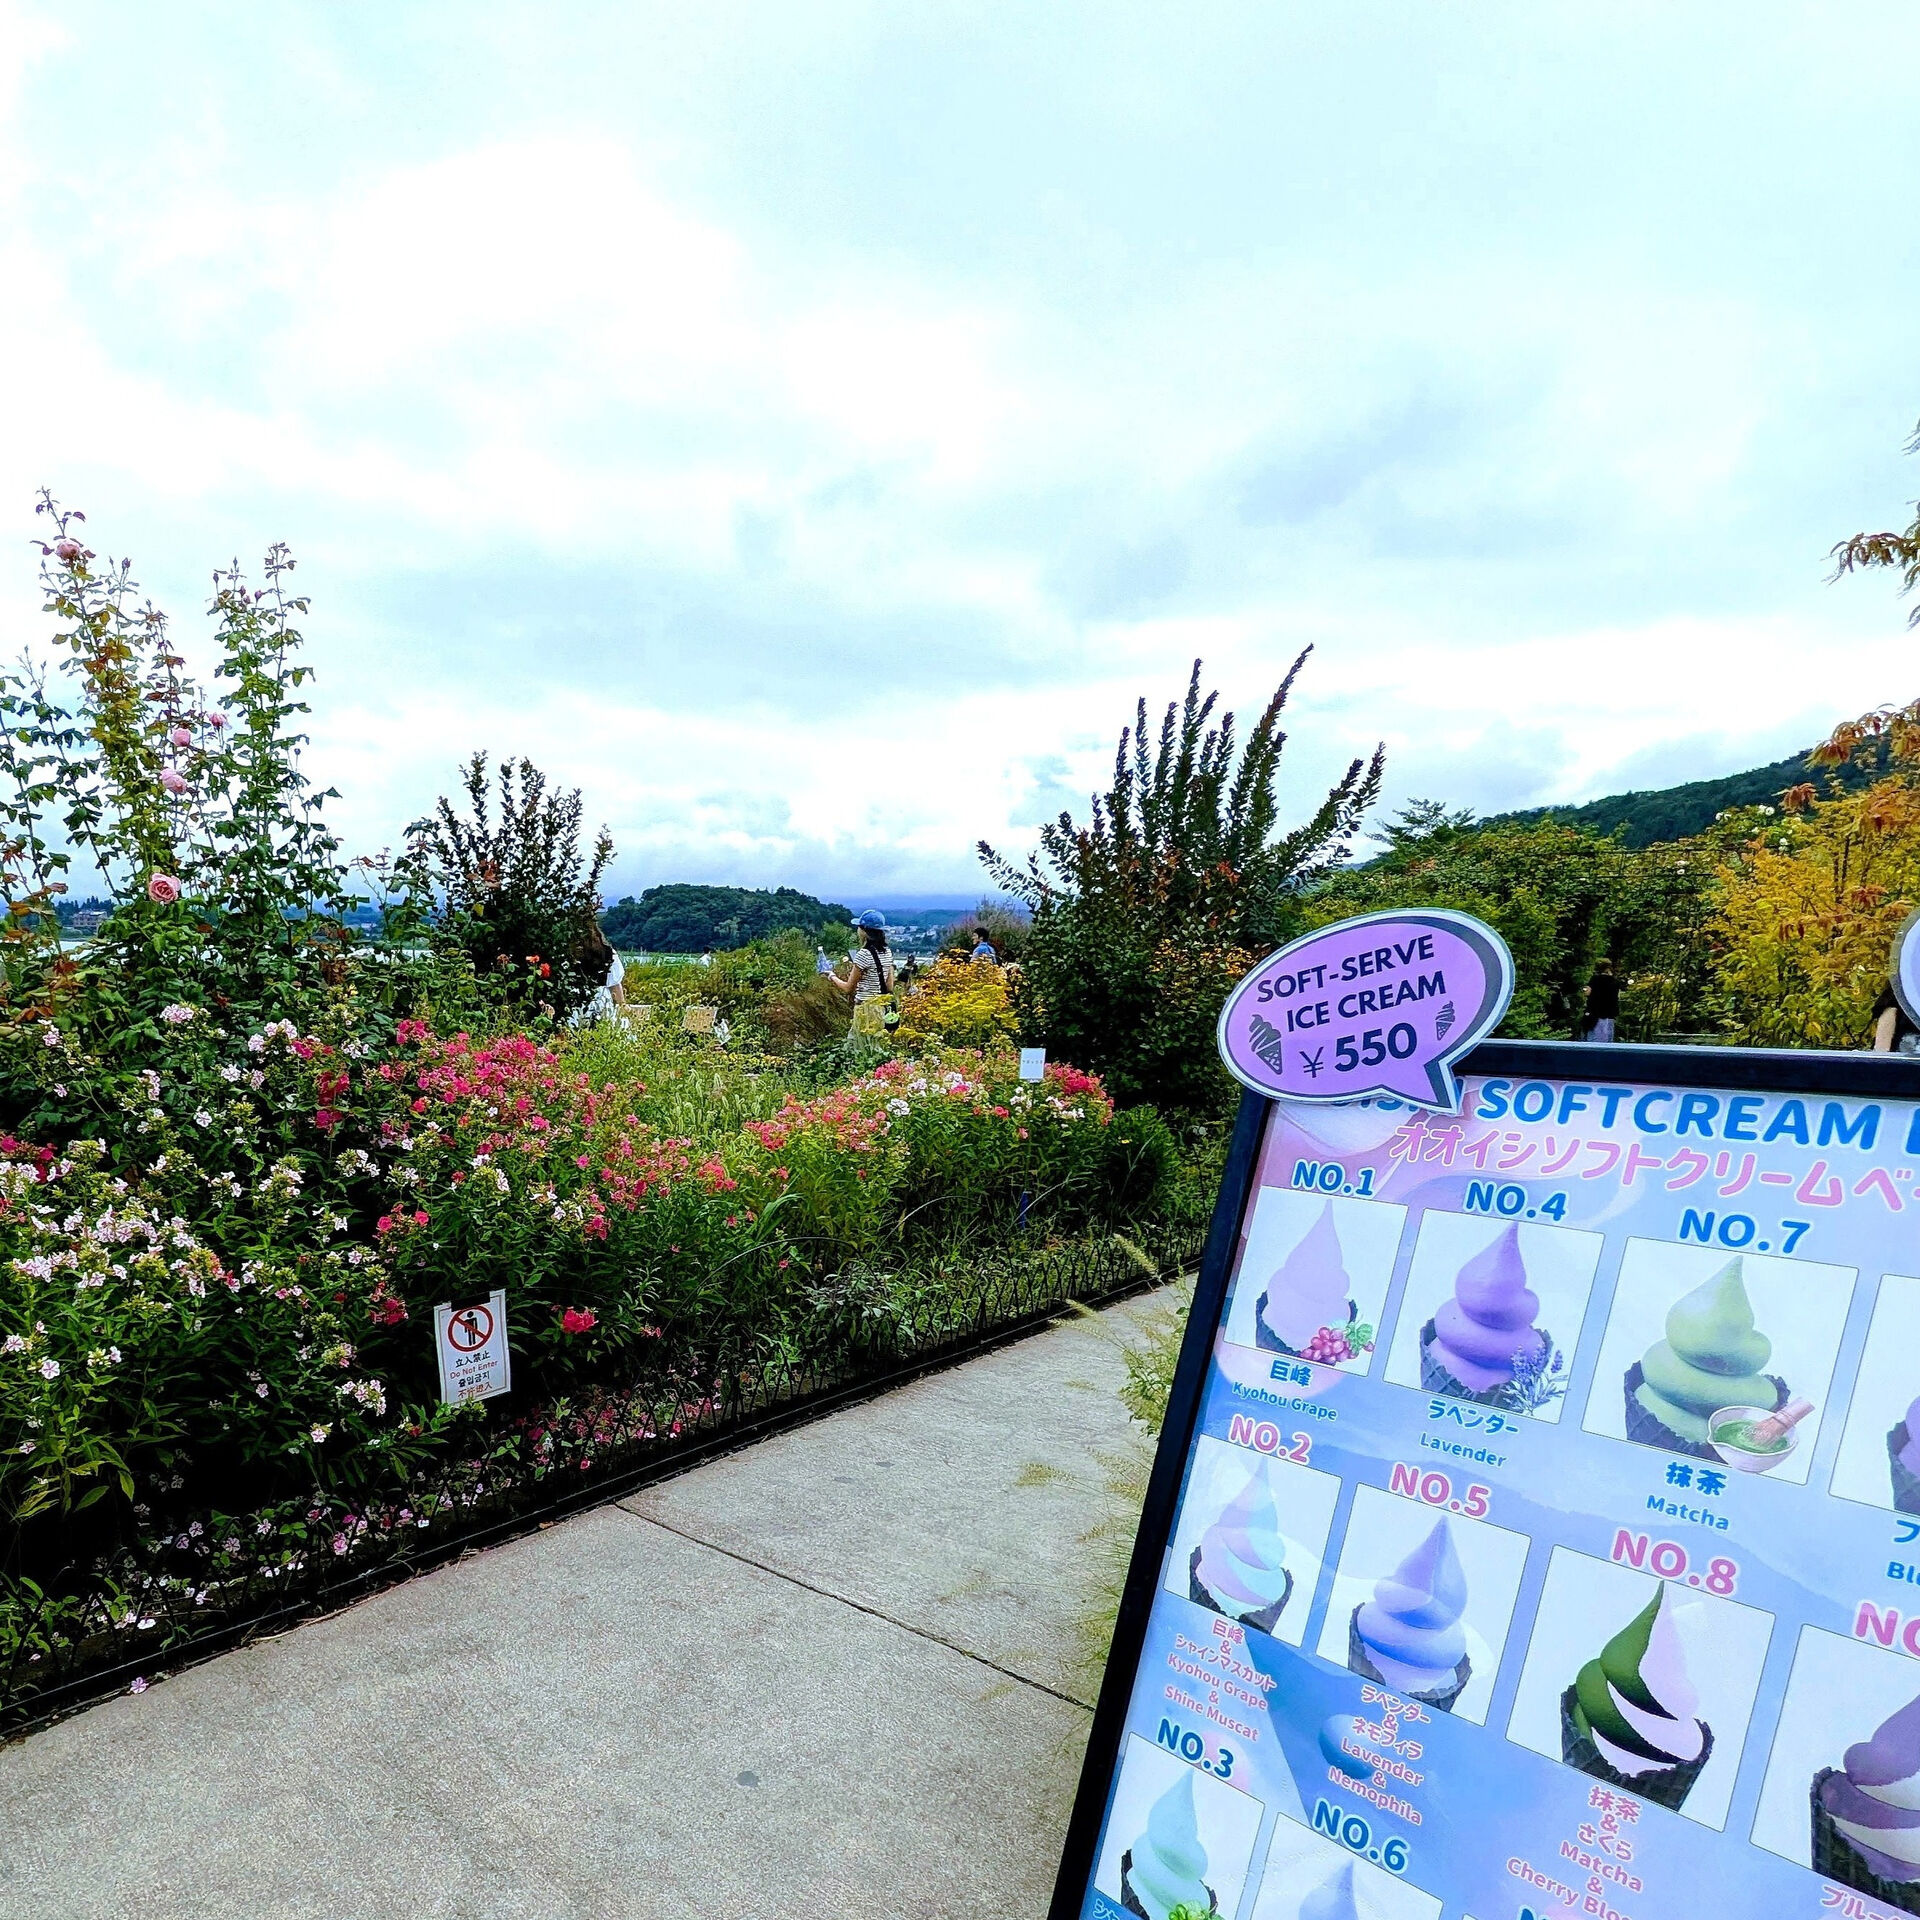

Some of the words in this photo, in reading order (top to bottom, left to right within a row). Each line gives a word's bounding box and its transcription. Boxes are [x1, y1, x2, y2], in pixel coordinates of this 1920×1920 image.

[1257, 934, 1435, 1002] SOFT-SERVE
[1286, 1001, 1330, 1032] ICE
[1337, 970, 1446, 1018] CREAM
[1477, 1079, 1881, 1150] SOFTCREAM
[1292, 1162, 1374, 1195] NO.1
[1391, 1124, 1920, 1211] オオイシソフトクリームベ
[1466, 1182, 1566, 1221] NO.4
[1679, 1209, 1810, 1254] NO.7
[450, 1371, 461, 1379] Do
[462, 1366, 476, 1375] Not
[478, 1360, 498, 1371] Enter
[456, 1350, 490, 1368] 立入禁止
[1269, 1359, 1312, 1387] 巨峰
[1233, 1382, 1287, 1406] Kyohou
[1291, 1398, 1337, 1421] Grape
[1429, 1399, 1518, 1433] ラベンダー
[1230, 1416, 1311, 1463] NO.2
[1420, 1432, 1507, 1467] Lavender
[1391, 1463, 1489, 1516] NO.5
[1666, 1462, 1727, 1495] 抹茶
[1646, 1495, 1729, 1530] Matcha
[1612, 1529, 1737, 1595] NO.8
[1213, 1619, 1243, 1644] 巨峰
[1220, 1640, 1231, 1655] &
[1168, 1653, 1220, 1688] Kyohou
[1224, 1681, 1267, 1711] Grape
[1176, 1635, 1277, 1691] シャインマスカット
[1165, 1686, 1204, 1713] Shine
[1206, 1706, 1259, 1741] Muscat
[1209, 1691, 1219, 1704] &
[1361, 1685, 1430, 1723] ラベンダー
[1353, 1717, 1423, 1759] ネモフィラ
[1383, 1714, 1398, 1731] &
[1158, 1718, 1234, 1778] NO.3
[1342, 1738, 1424, 1787] Lavender
[1329, 1767, 1421, 1825] Nemophila
[1373, 1771, 1386, 1787] &
[1589, 1786, 1641, 1823] 抹茶
[1600, 1814, 1618, 1834] &
[1315, 1801, 1408, 1871] NO.6
[1578, 1824, 1632, 1861] さくら
[1507, 1858, 1579, 1905] Cherry
[1560, 1841, 1642, 1892] Matcha
[1587, 1877, 1602, 1895] &
